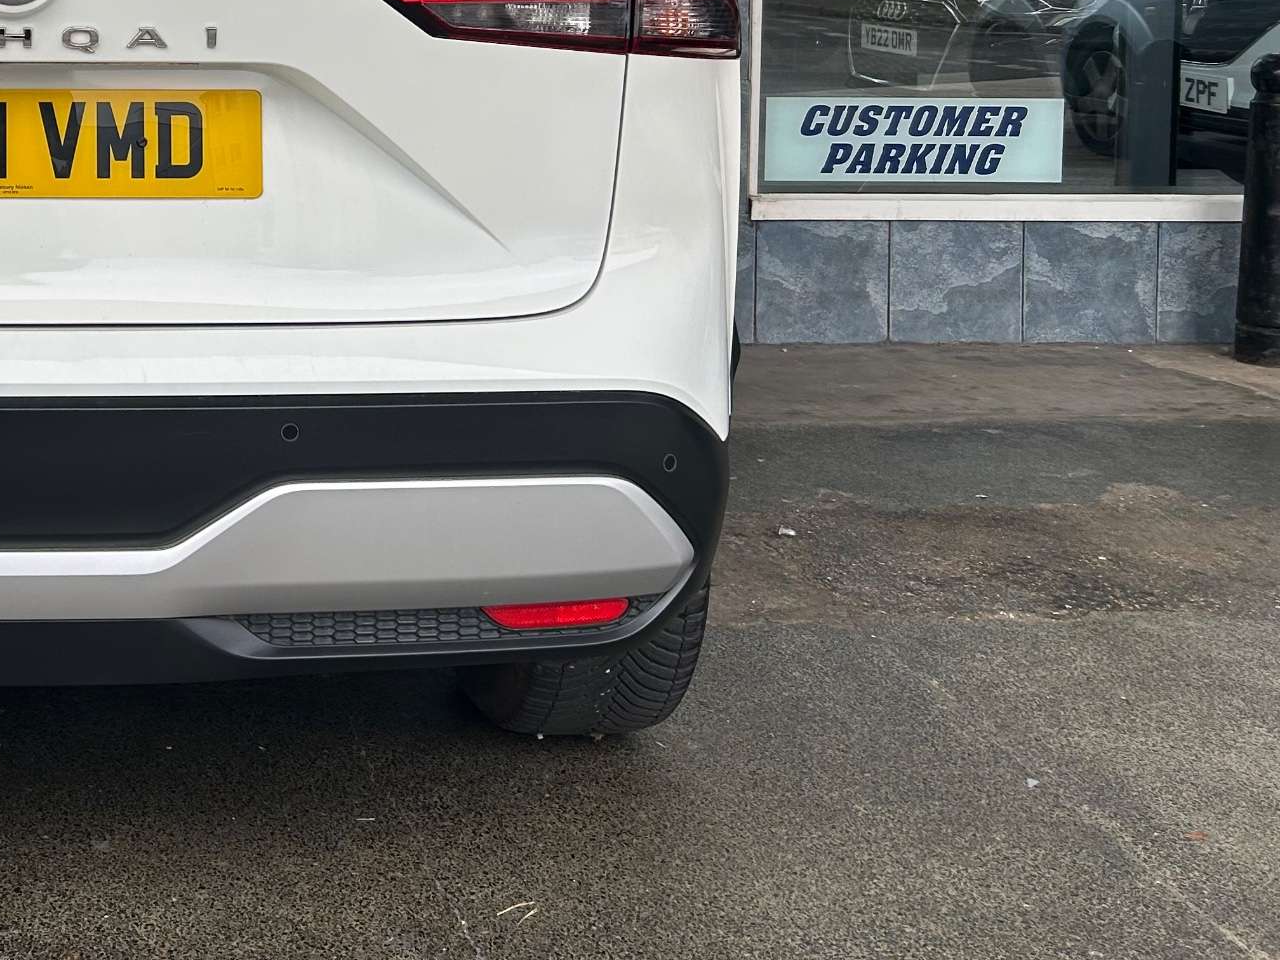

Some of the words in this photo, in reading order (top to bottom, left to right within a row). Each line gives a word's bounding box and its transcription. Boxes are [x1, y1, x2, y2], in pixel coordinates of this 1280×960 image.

[1184, 77, 1219, 106] ZPF
[800, 104, 1029, 137] CUSTOMER
[38, 102, 204, 180] VMD
[820, 143, 1006, 176] PARKING
